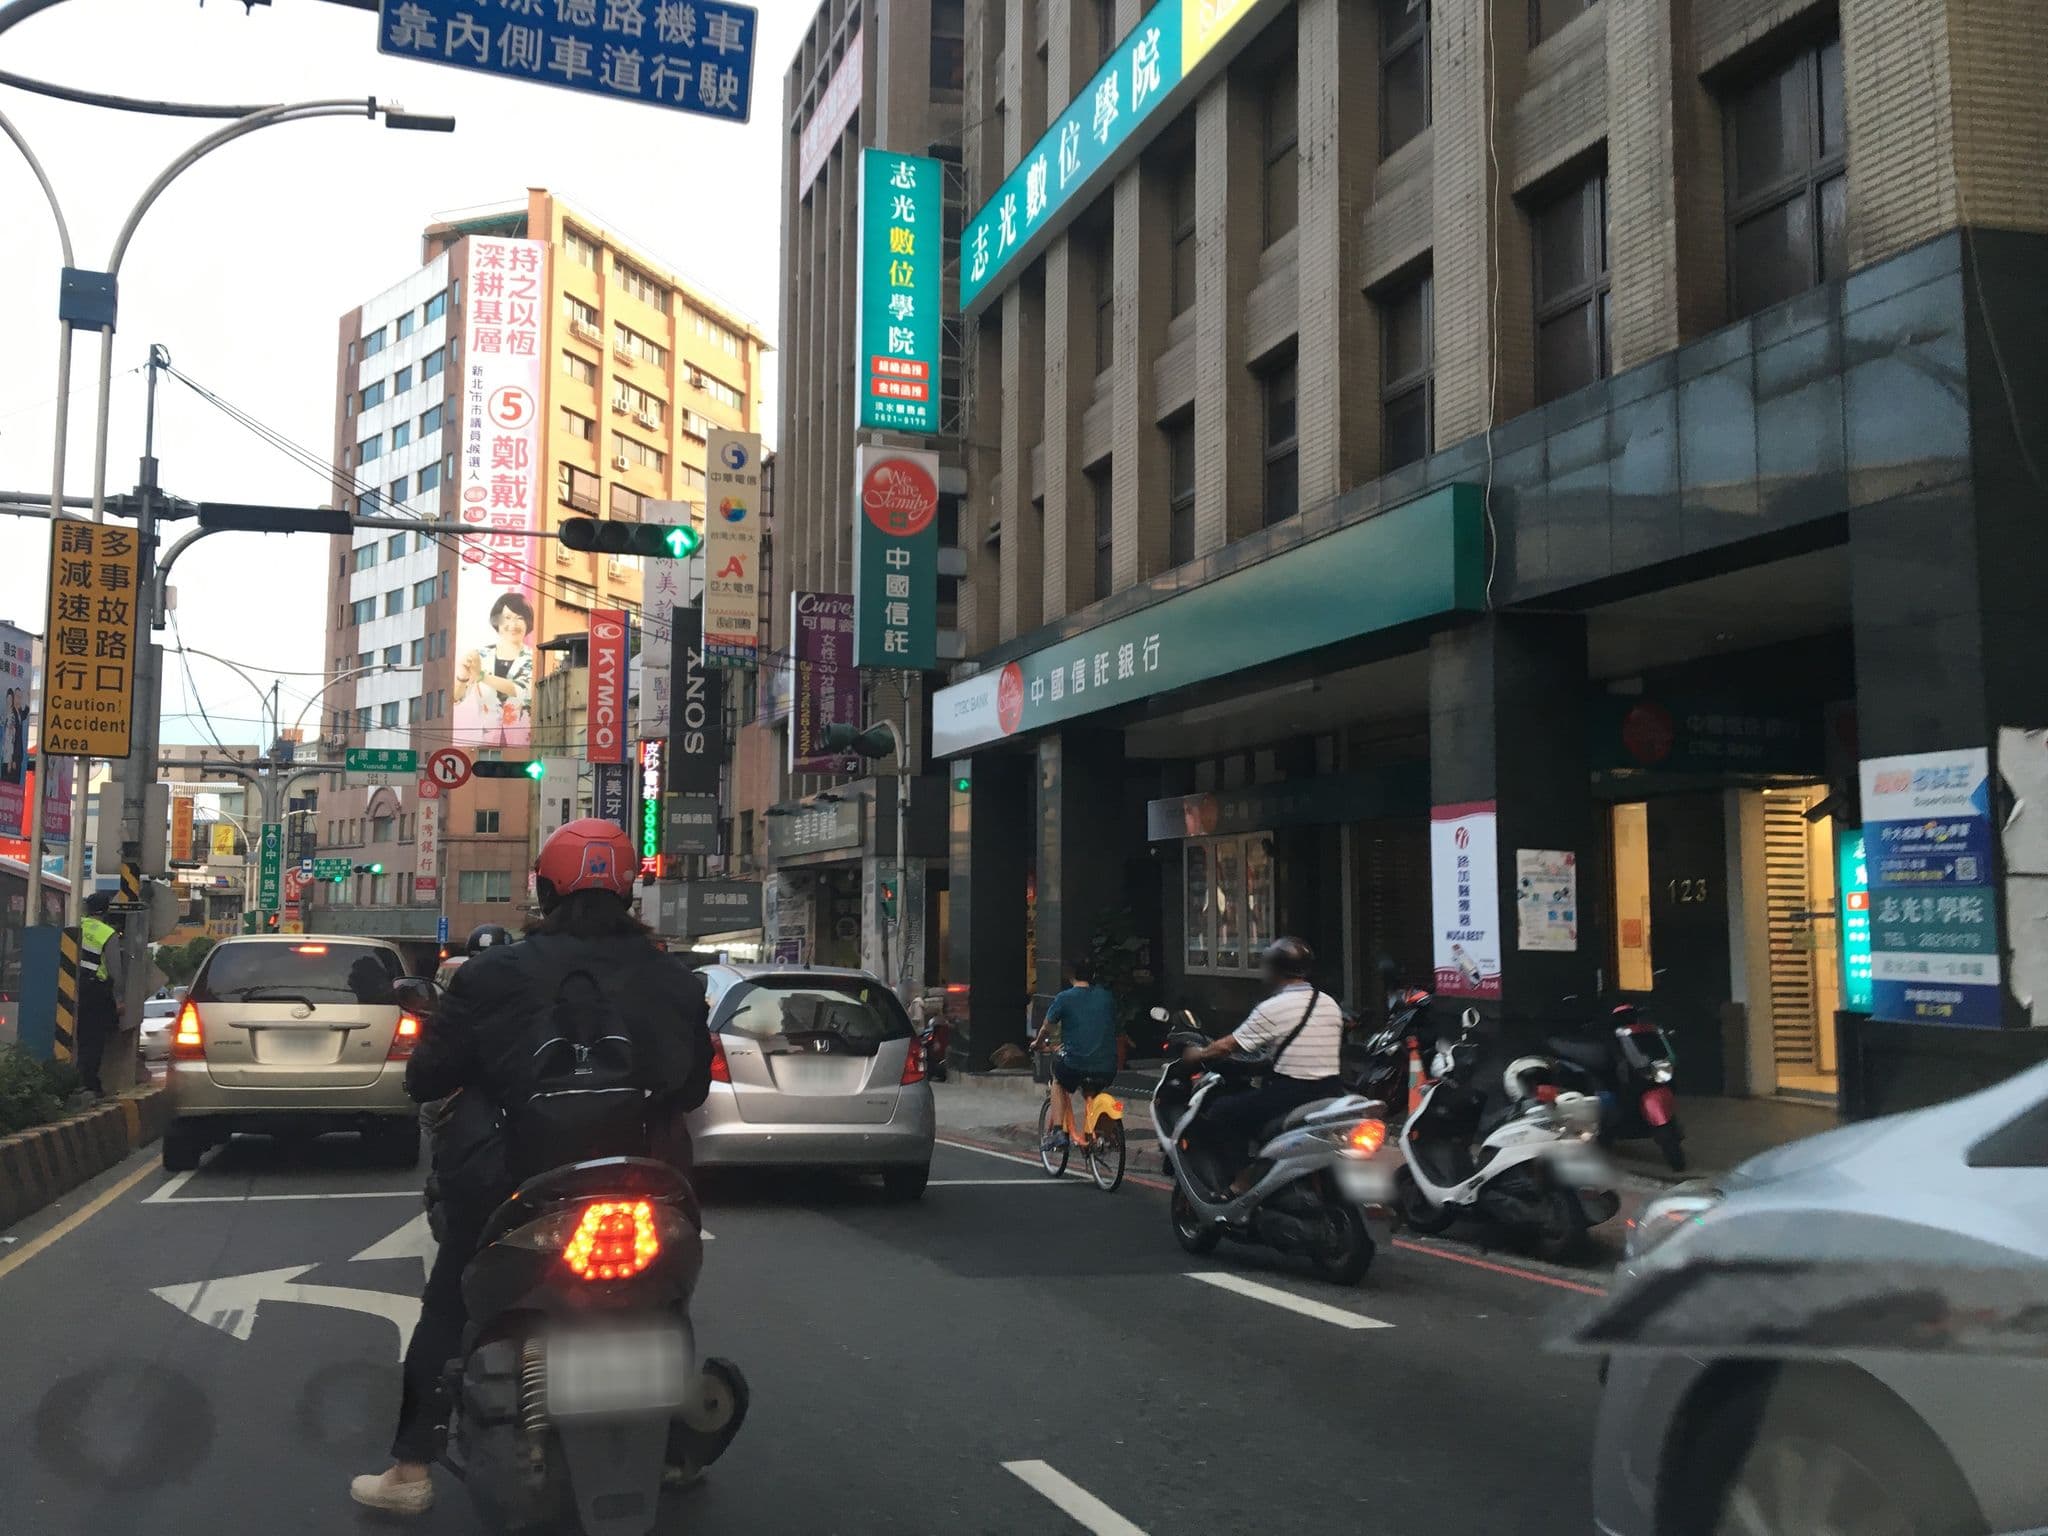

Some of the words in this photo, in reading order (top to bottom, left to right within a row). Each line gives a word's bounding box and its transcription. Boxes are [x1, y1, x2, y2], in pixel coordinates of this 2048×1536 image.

[390, 9, 741, 113] 靠內側車道行駛
[475, 0, 744, 55] 德路機車
[971, 27, 1160, 283] 志光數位學院
[472, 243, 505, 354] 深耕基層
[507, 246, 538, 356] 持之以恆
[888, 161, 916, 356] 志光數位學院
[500, 391, 522, 421] 5
[488, 435, 528, 585] 鄭戴麗香
[54, 525, 94, 691] 請減速慢行
[95, 529, 132, 693] 多事故路口
[884, 546, 910, 653] 中國信託
[596, 648, 616, 749] KYMCO
[684, 647, 706, 754] SONY
[1031, 633, 1160, 707] 中國信託銀行
[50, 714, 126, 733] Accident
[50, 733, 88, 751] Area
[358, 751, 408, 762] 原德路
[266, 849, 276, 890] 中山路
[1668, 878, 1707, 903] 123
